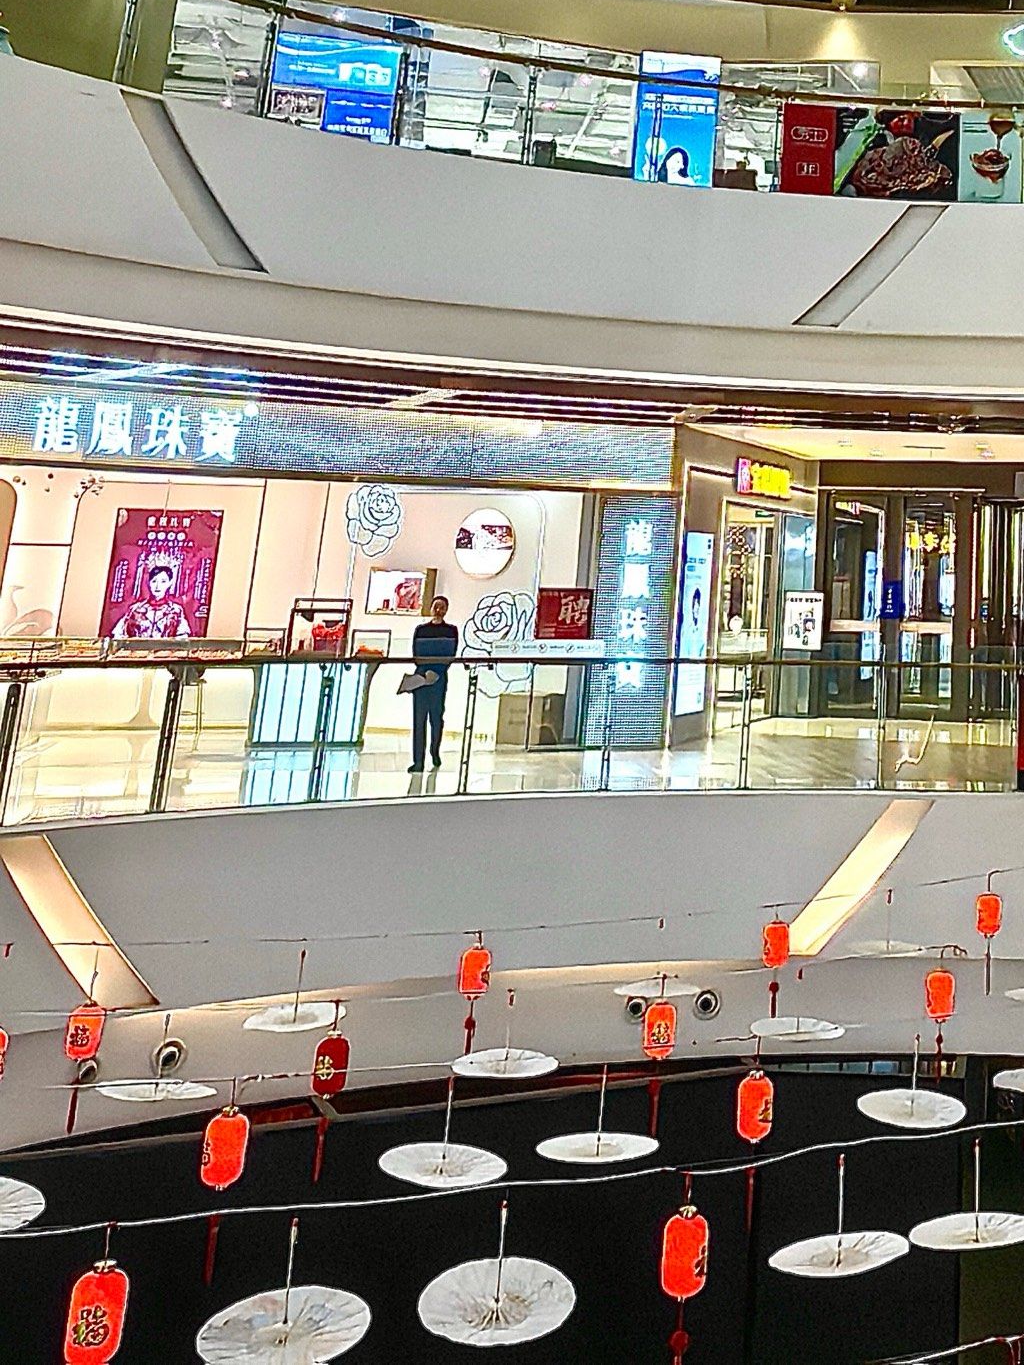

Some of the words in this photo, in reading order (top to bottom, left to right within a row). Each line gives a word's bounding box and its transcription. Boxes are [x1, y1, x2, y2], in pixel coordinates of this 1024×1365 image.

[31, 396, 244, 465] 龍鳳珠寶
[558, 592, 590, 626] 聘
[73, 1305, 110, 1347] 福
